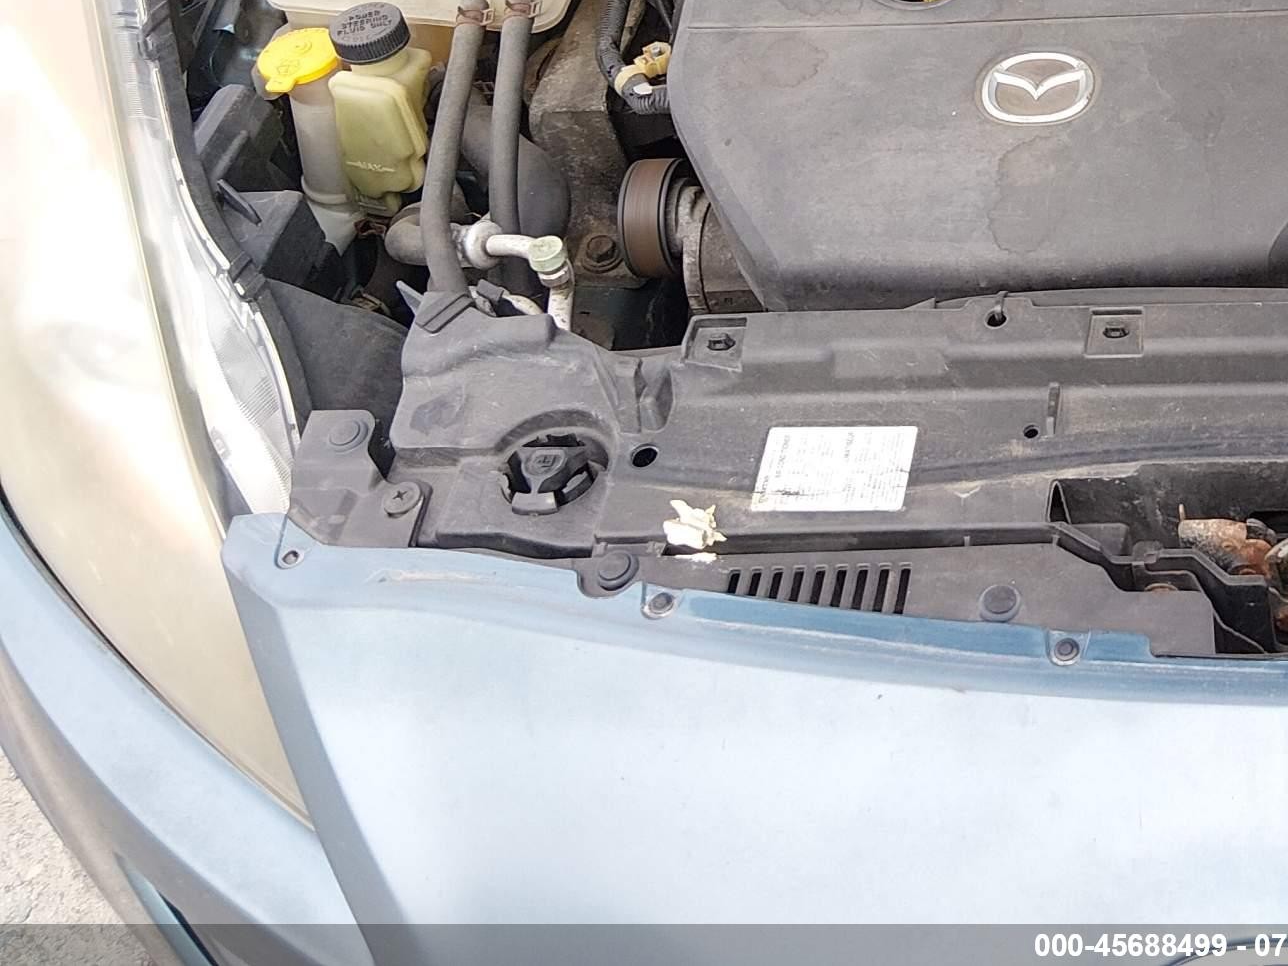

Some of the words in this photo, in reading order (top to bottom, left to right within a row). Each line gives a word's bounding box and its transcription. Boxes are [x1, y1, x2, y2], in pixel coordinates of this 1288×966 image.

[342, 14, 388, 30] STEERING
[348, 10, 381, 21] POWER
[336, 25, 366, 36] FLUID
[370, 20, 392, 29] ONLY
